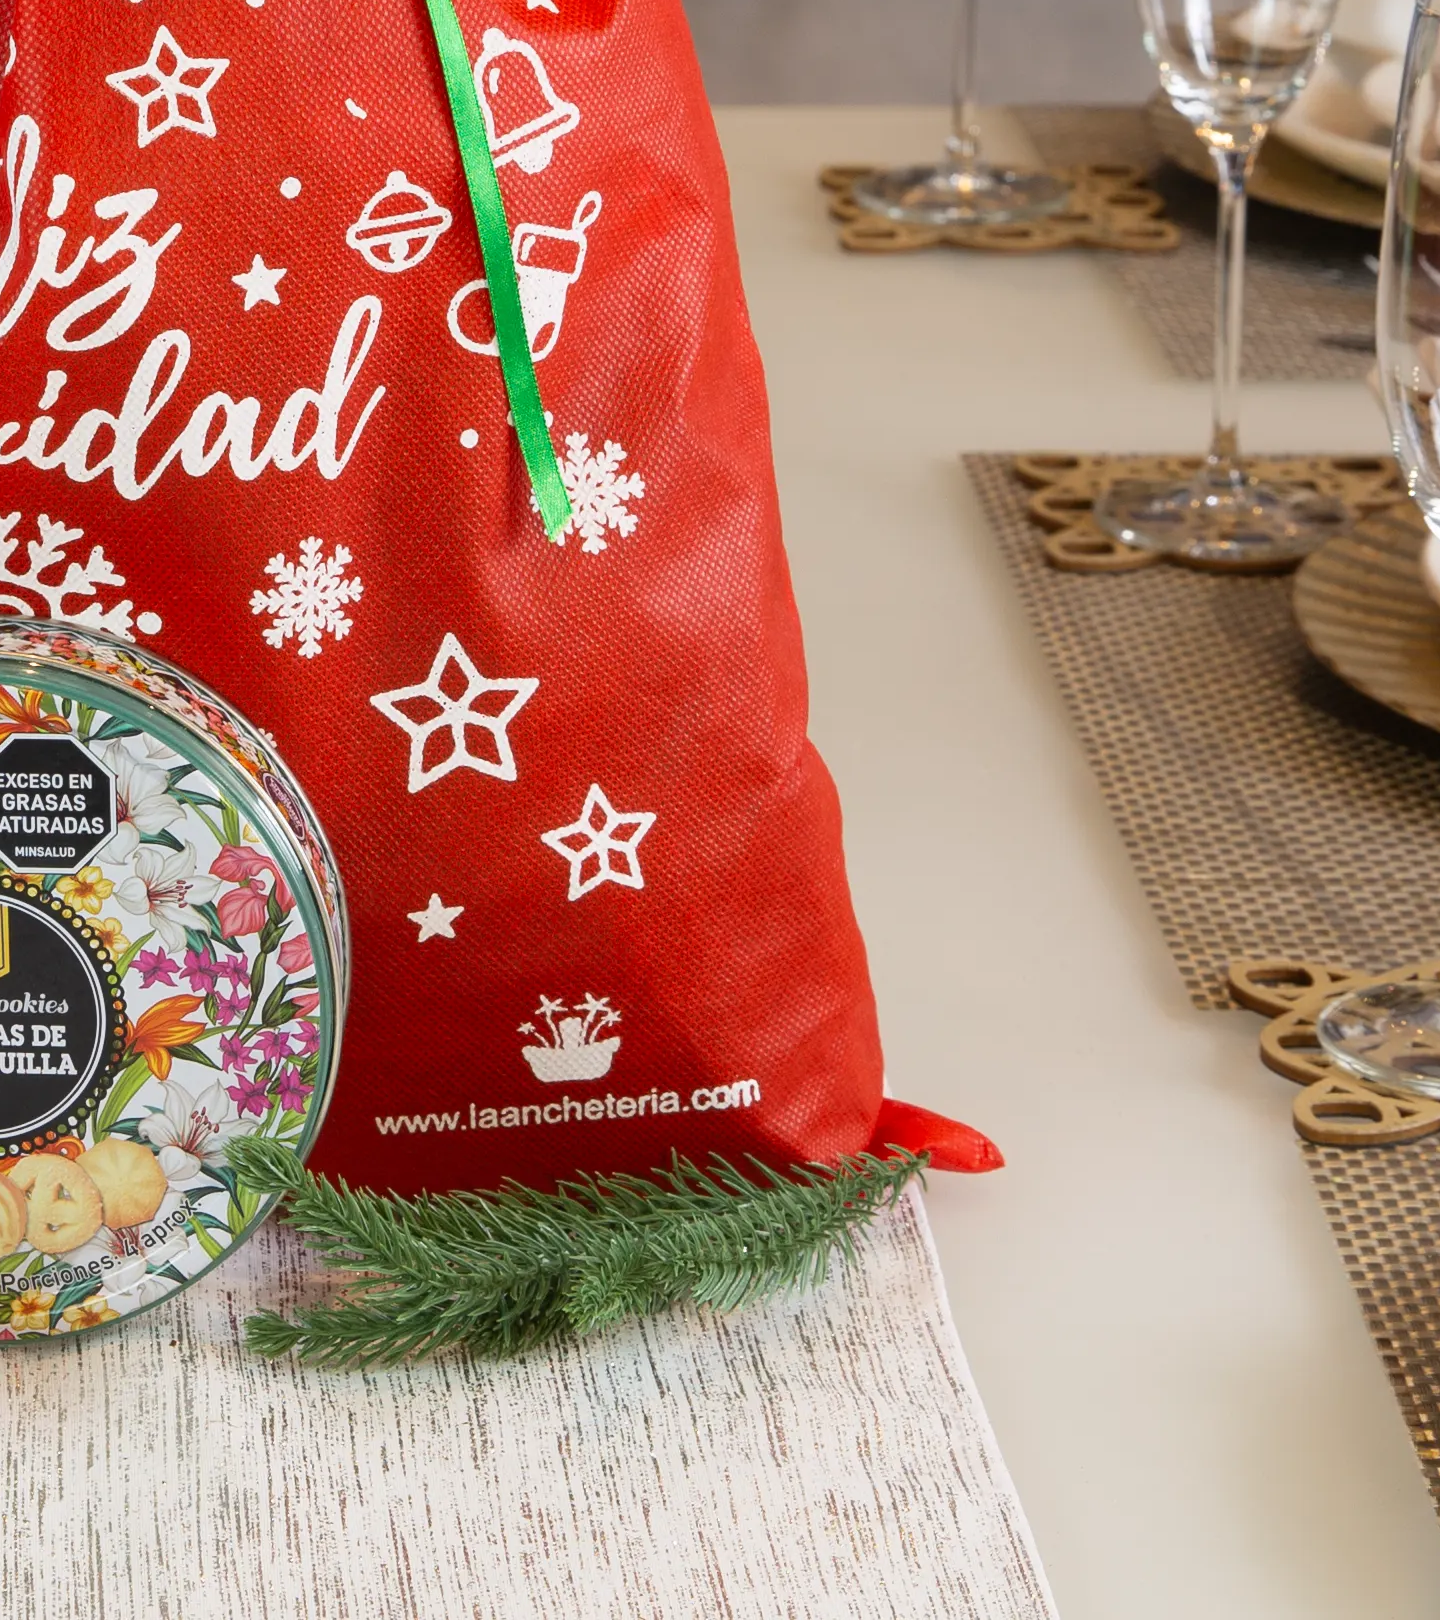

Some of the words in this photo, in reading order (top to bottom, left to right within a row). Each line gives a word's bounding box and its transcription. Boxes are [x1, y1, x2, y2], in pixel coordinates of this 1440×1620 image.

[68, 773, 92, 789] EN
[2, 793, 86, 812] GRASAS
[14, 846, 76, 858] MINSALUD
[31, 1024, 66, 1047] DE
[375, 1078, 761, 1136] www.laancheteria.com
[1, 1256, 122, 1292] Porciones:
[123, 1237, 139, 1256] 4
[141, 1198, 202, 1248] aprox.
